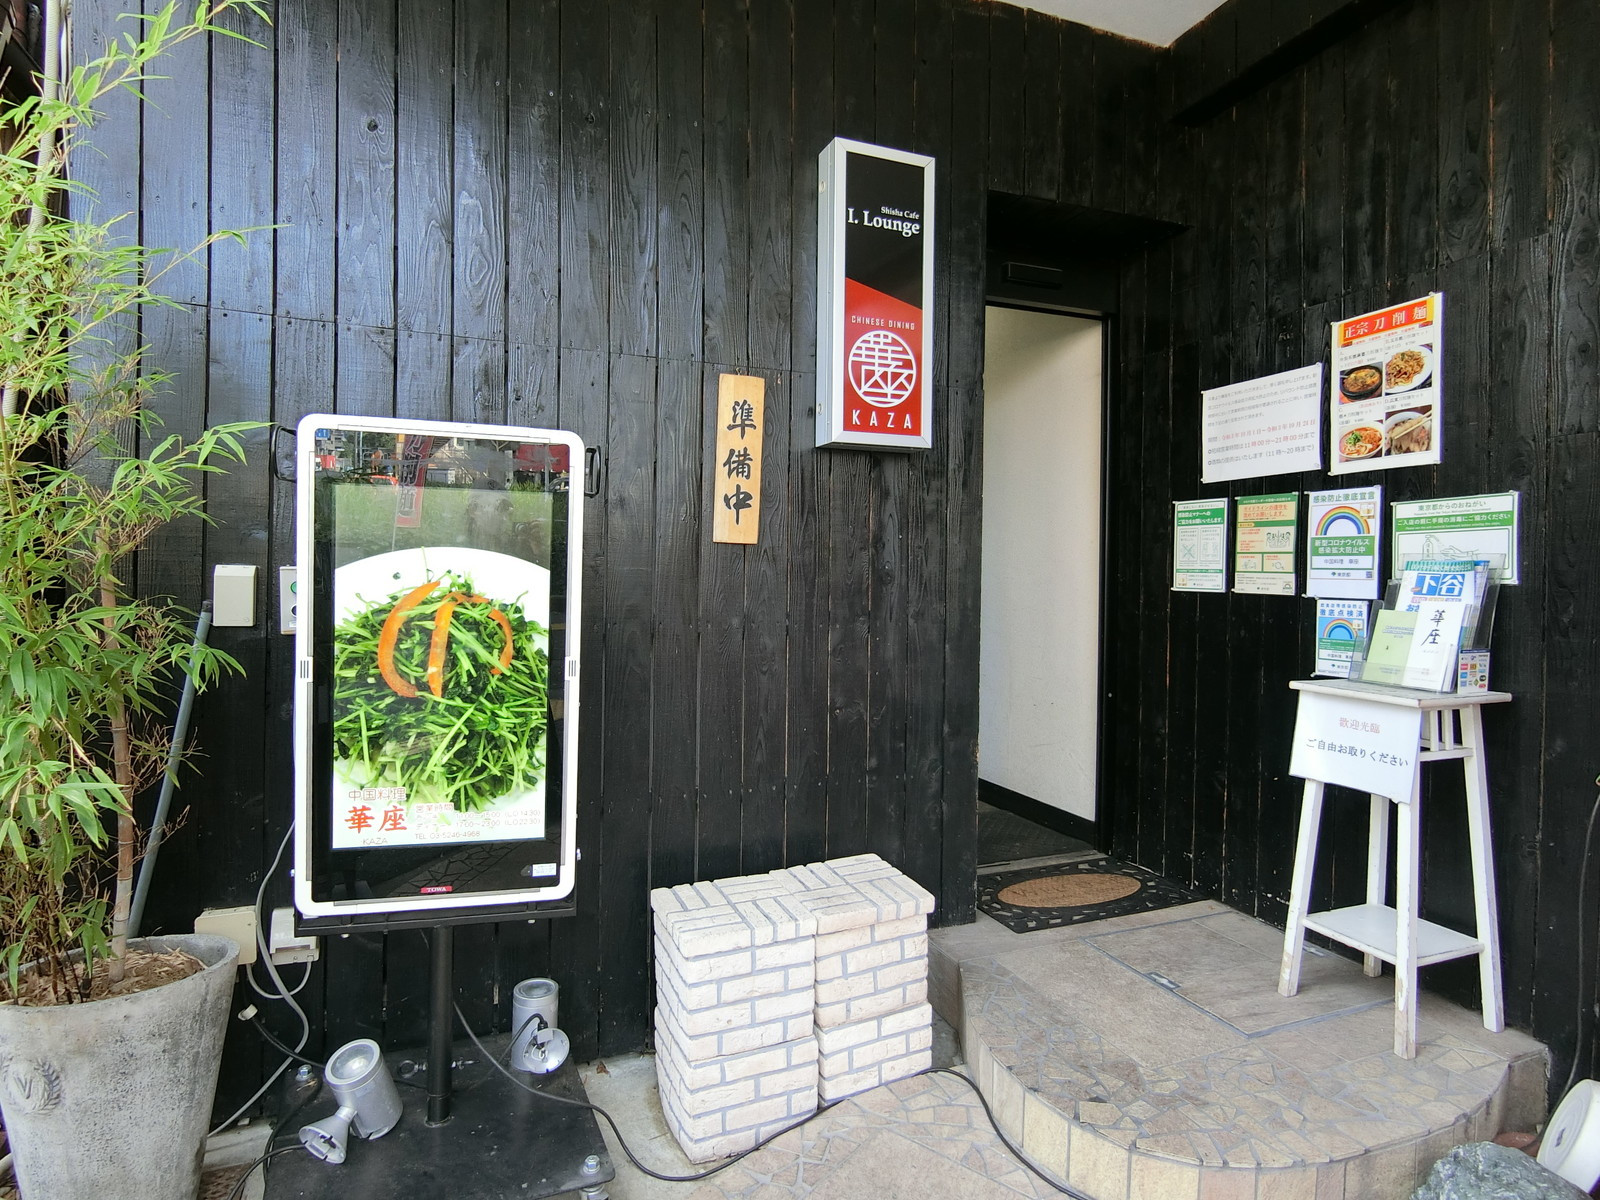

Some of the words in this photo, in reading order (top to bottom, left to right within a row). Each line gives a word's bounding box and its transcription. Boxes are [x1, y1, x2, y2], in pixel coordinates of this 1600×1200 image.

[880, 206, 903, 217] Shisha
[904, 210, 920, 220] Cafe
[863, 210, 920, 237] Lounge
[851, 315, 884, 327] CHINESE
[888, 319, 915, 331] DINING
[852, 409, 912, 429] KAZA
[723, 399, 757, 526] 準備中
[1313, 491, 1375, 504] 感染防止徹底宣言
[1418, 500, 1487, 511] 東京都からのおねがい
[1315, 538, 1370, 547] 新型コロナウイルス
[1318, 546, 1366, 554] 感染拡大防止中
[1415, 573, 1466, 596] 下谷
[1306, 739, 1409, 767] ご自由お取りください
[348, 787, 407, 801] 中国料理
[344, 805, 407, 832] 華座
[362, 837, 388, 845] KAZA
